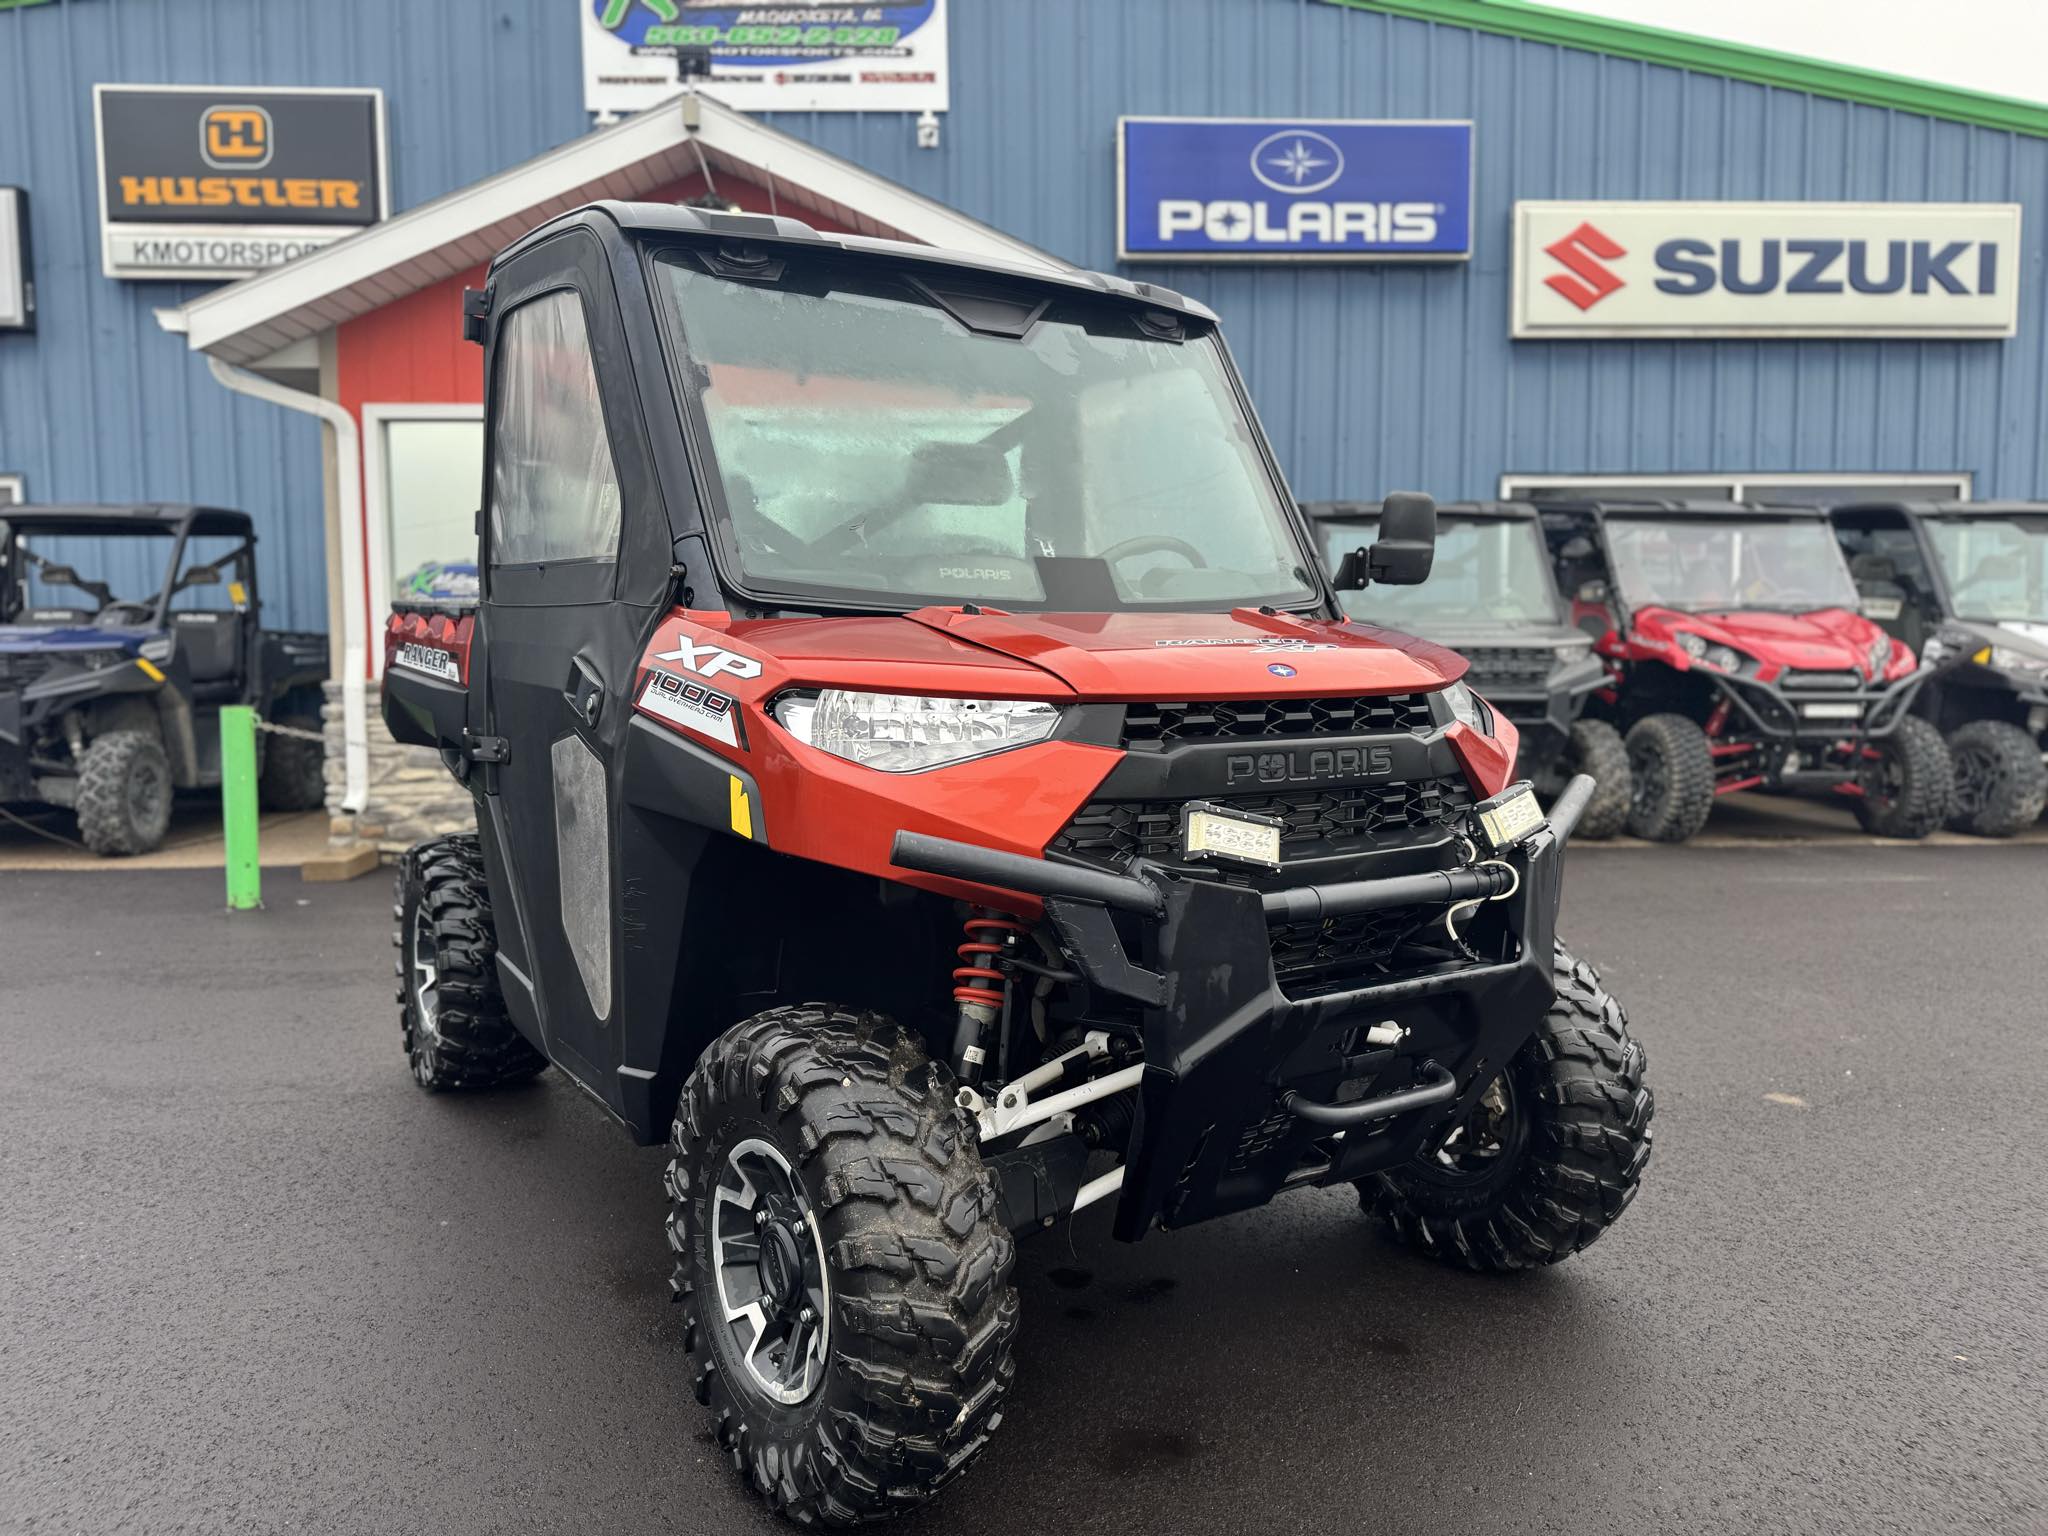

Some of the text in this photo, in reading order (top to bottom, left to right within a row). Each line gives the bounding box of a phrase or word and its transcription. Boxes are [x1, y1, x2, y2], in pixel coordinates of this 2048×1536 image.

[119, 176, 361, 208] HUSTLER
[1158, 200, 1438, 243] POLARIS
[1653, 238, 1998, 296] SUZUKI
[939, 567, 1012, 580] POLARIS
[403, 642, 450, 674] RANGER
[650, 632, 764, 680] XP
[1155, 638, 1308, 647] RANGER
[650, 688, 723, 723] DUAL OVERHEAD CAM
[651, 669, 733, 716] 1000
[1227, 746, 1392, 785] POLARIS
